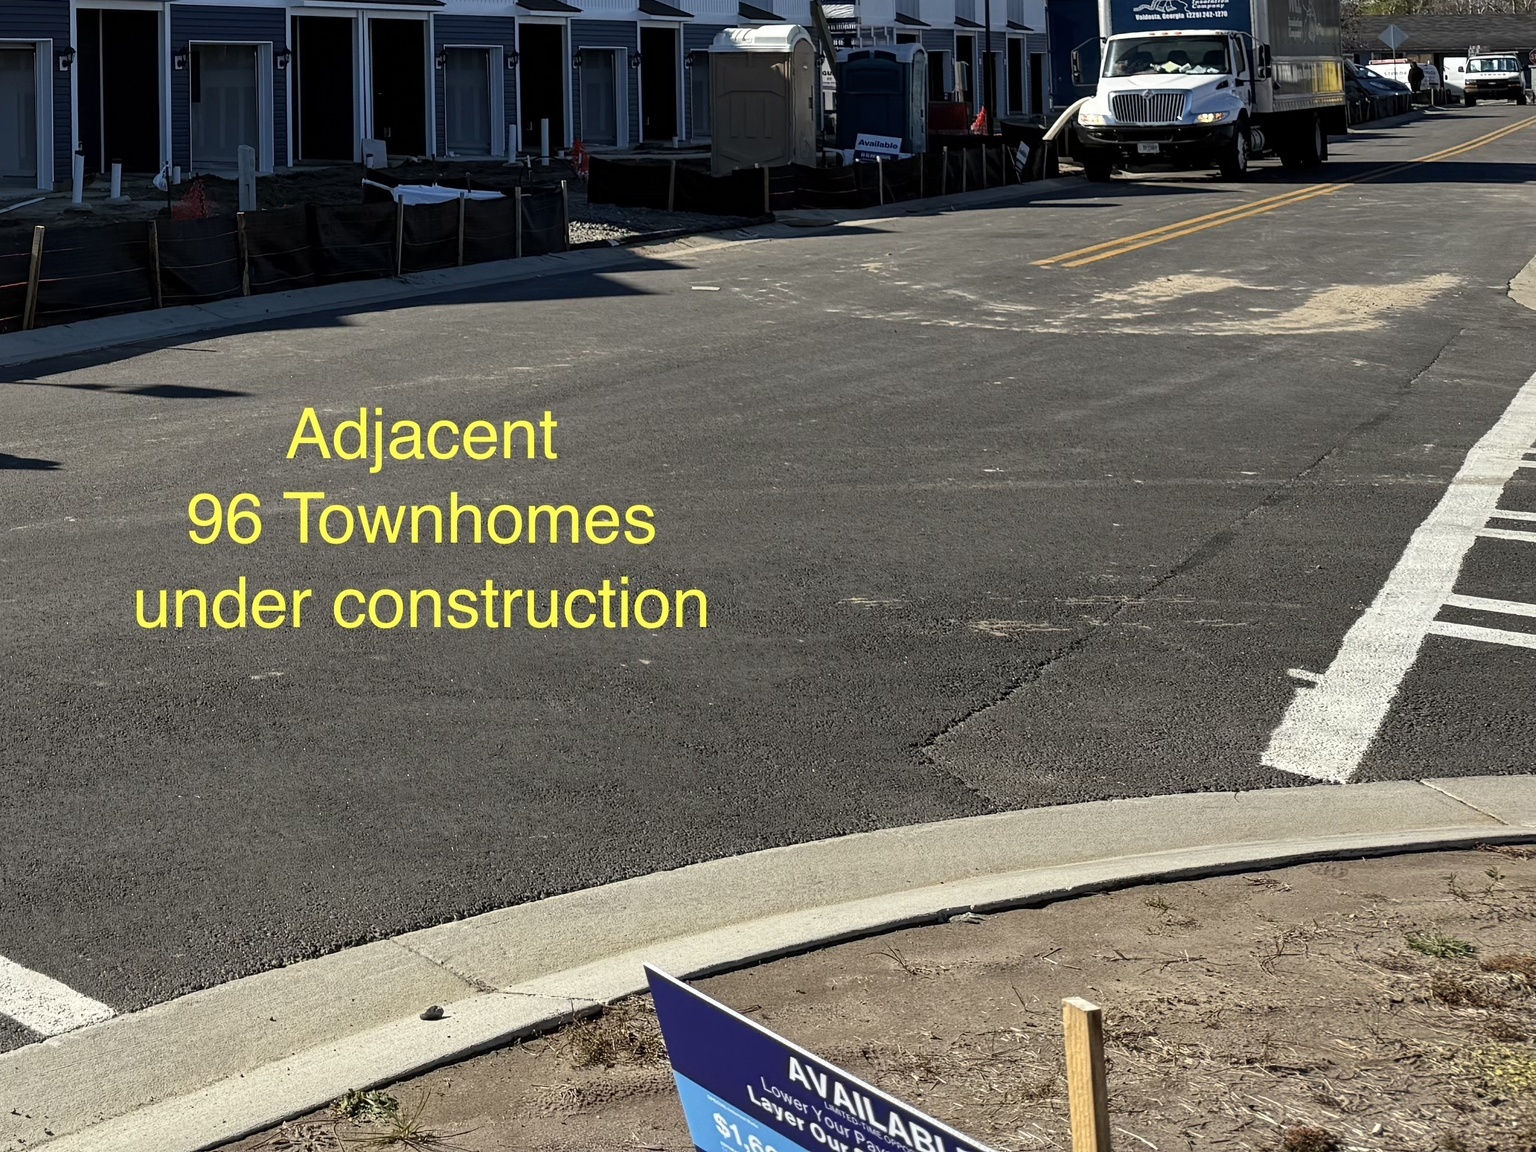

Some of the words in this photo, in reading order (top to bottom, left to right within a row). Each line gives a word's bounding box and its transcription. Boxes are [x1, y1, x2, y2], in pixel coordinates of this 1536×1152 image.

[1162, 12, 1185, 20] Georgia
[858, 139, 898, 149] Available
[747, 1084, 805, 1132] Layer
[760, 1076, 808, 1114] Lower
[811, 1105, 851, 1138] Your
